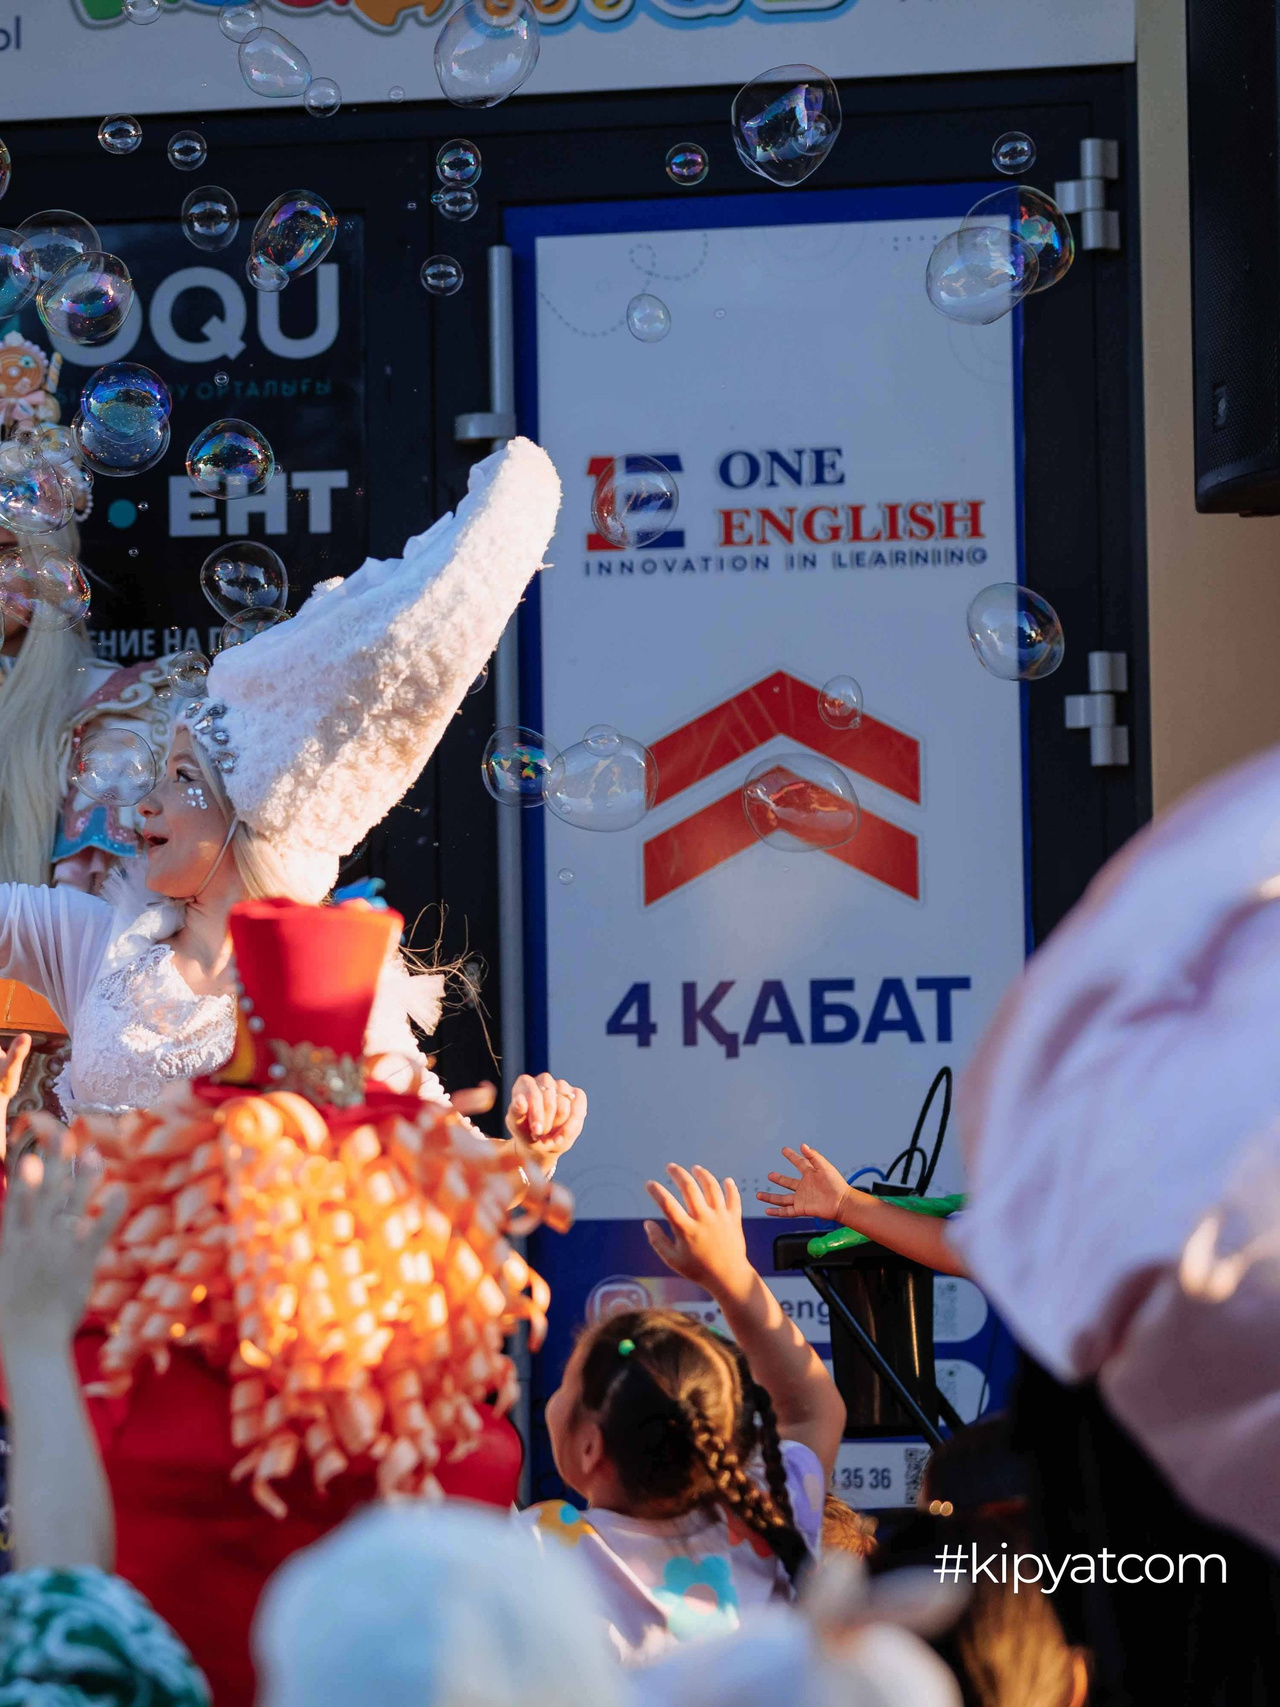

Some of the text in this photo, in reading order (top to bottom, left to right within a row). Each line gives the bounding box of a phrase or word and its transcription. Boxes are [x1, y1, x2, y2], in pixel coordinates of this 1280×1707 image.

[719, 447, 846, 489] ONE
[719, 500, 986, 547] ENGLISH
[584, 547, 989, 578] INNOVATION IN LEARNING
[605, 976, 971, 1059] 4 ҚАБАТ
[841, 1467, 864, 1490] 35
[869, 1467, 892, 1490] 36
